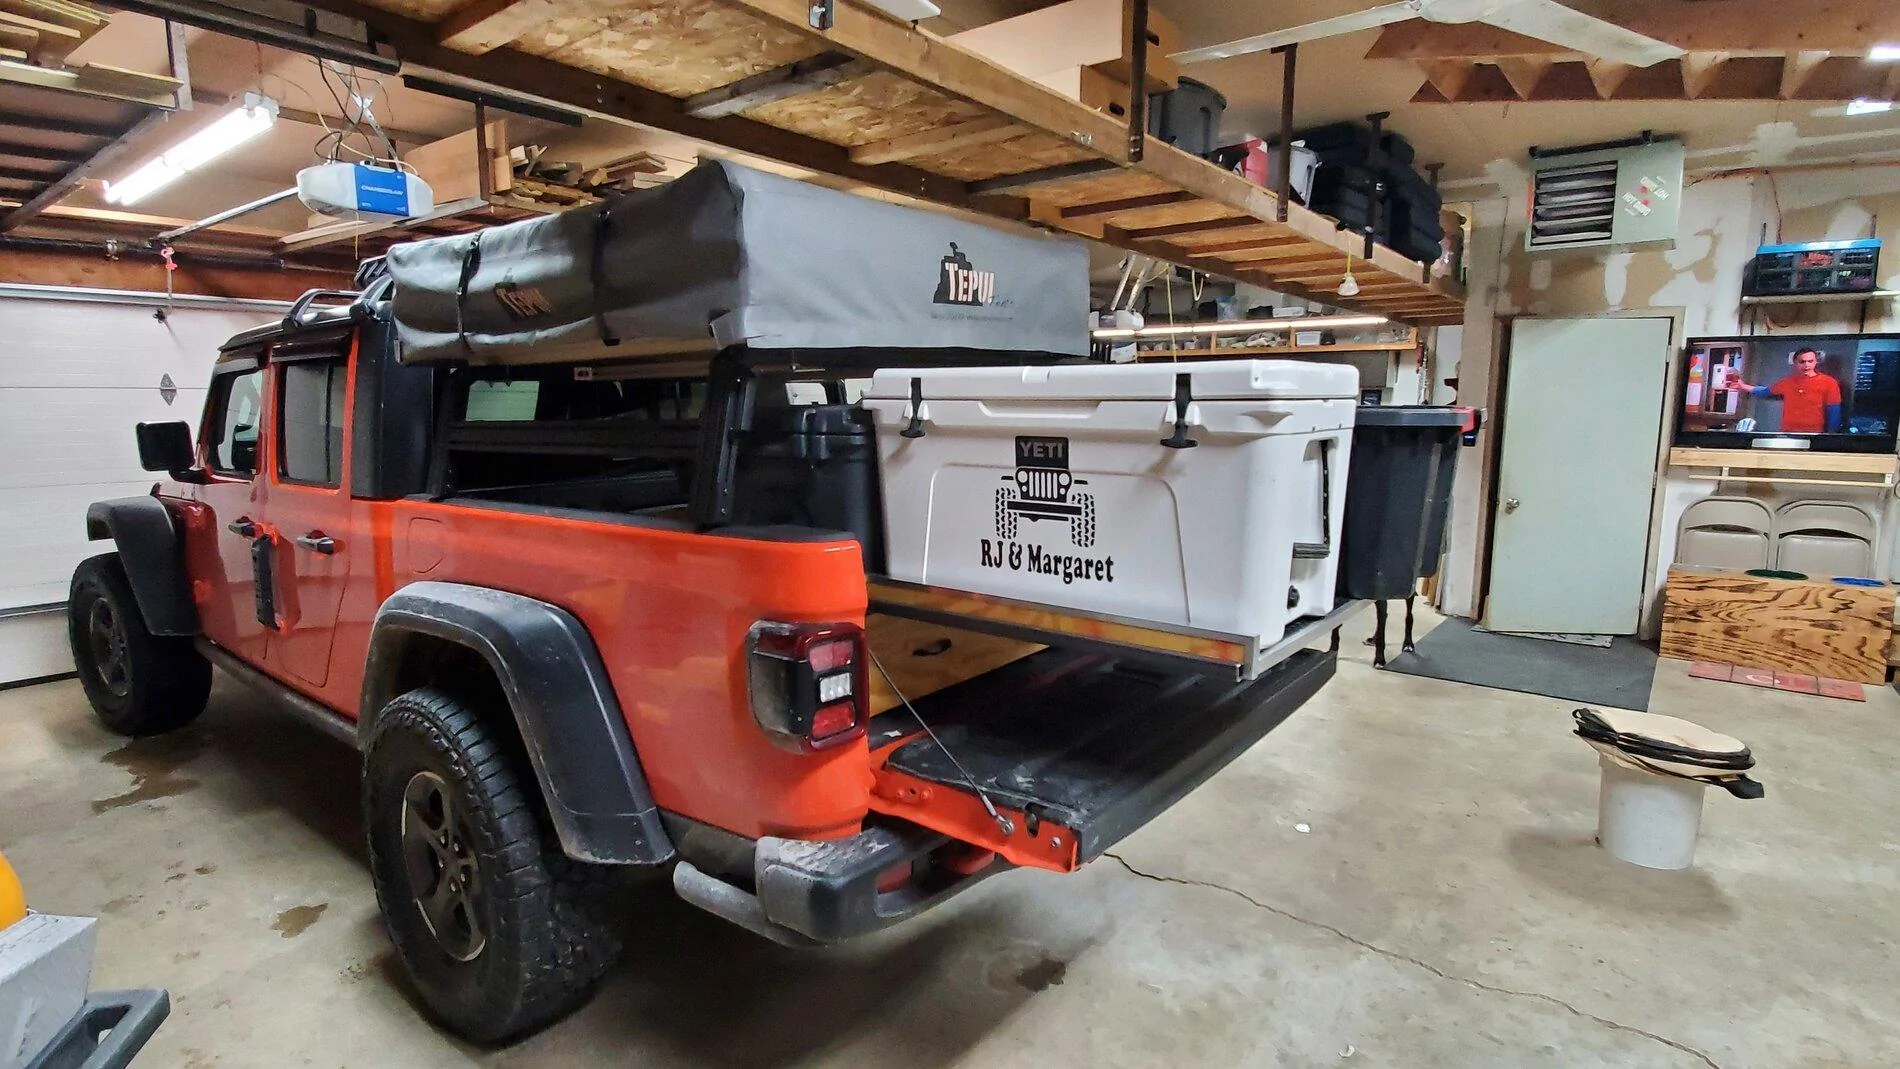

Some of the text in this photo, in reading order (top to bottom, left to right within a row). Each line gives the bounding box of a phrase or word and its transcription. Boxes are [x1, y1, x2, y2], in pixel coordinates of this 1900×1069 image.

[1019, 440, 1063, 459] YETI
[980, 538, 1114, 584] RJ & Margaret
